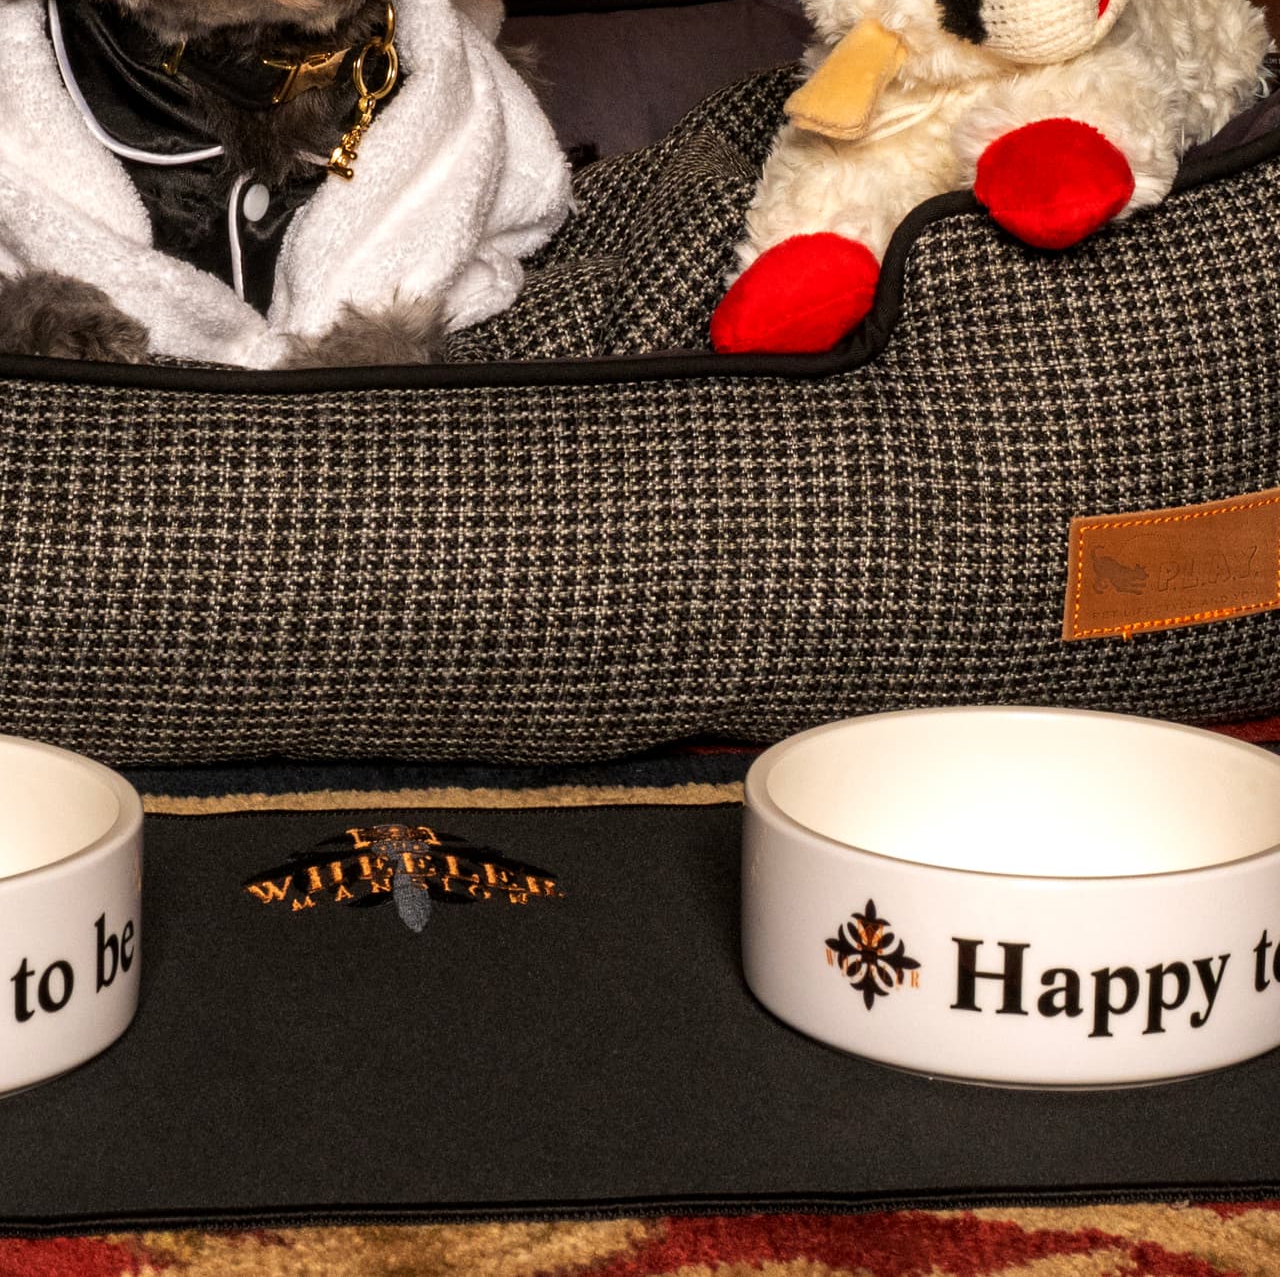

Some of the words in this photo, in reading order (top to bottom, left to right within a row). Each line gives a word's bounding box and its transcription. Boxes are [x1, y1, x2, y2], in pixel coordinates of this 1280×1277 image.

[9, 957, 76, 1025] to
[93, 909, 136, 996] be
[949, 935, 1233, 1039] Happy
